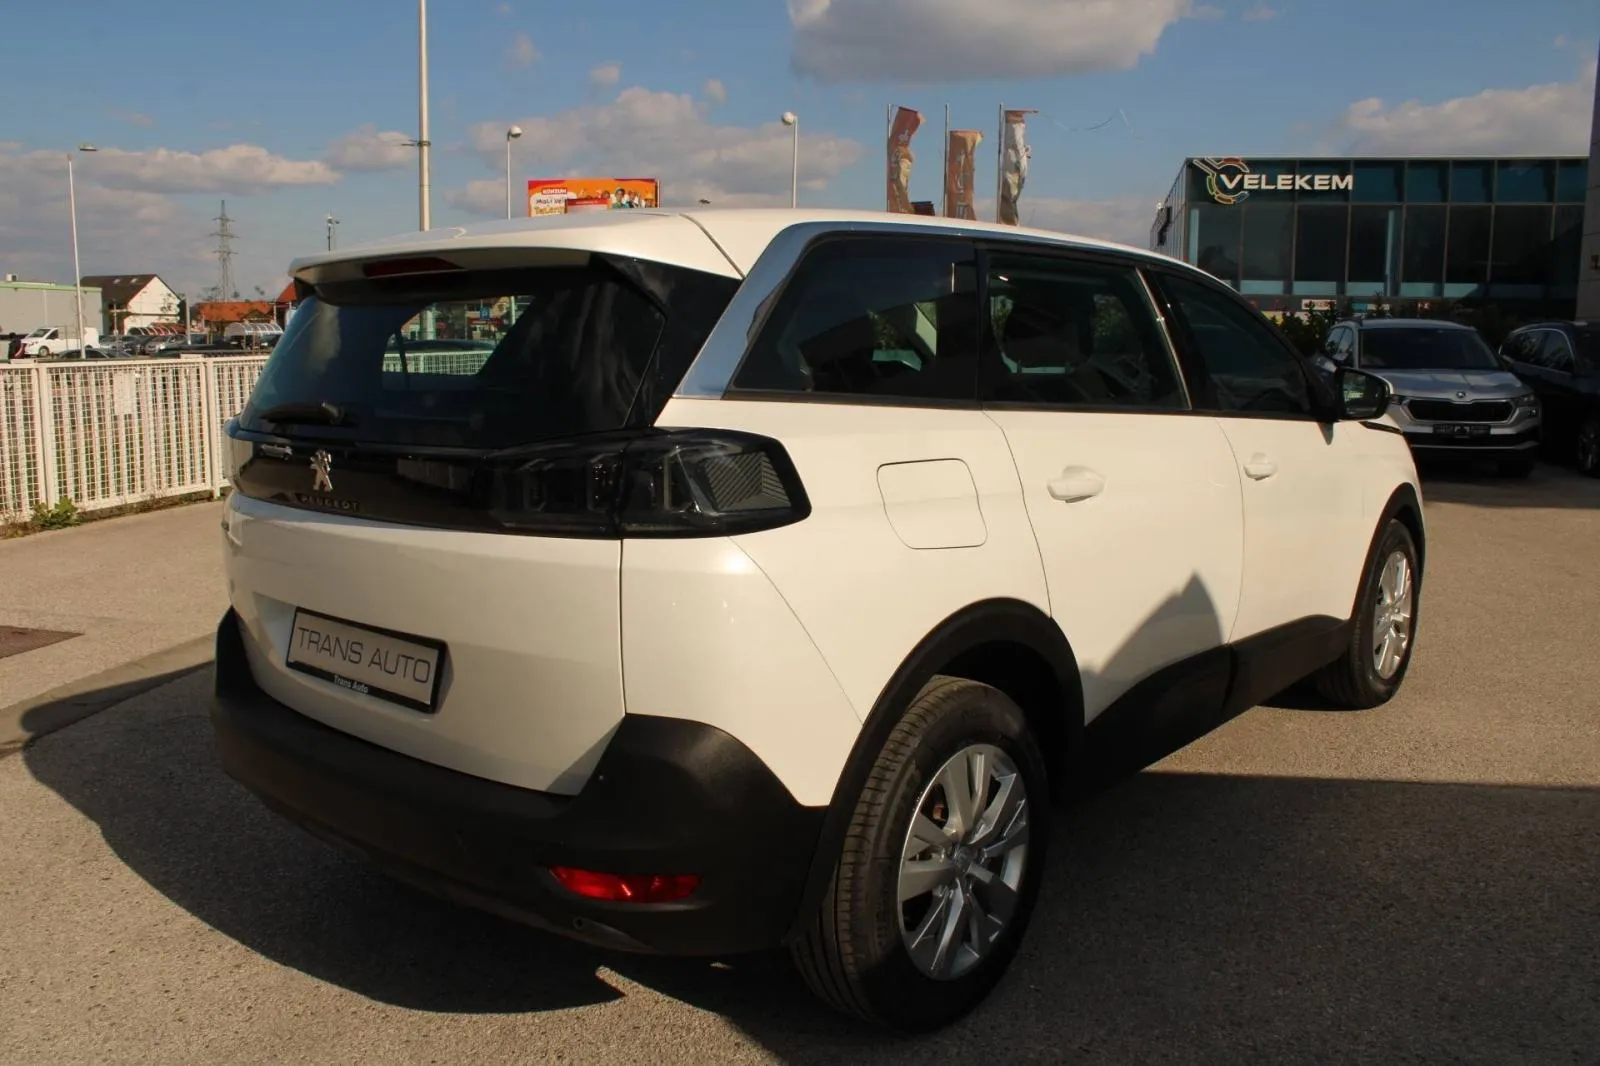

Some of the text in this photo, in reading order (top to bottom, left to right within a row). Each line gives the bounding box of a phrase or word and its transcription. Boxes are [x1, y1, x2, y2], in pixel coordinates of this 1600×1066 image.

[1219, 174, 1353, 191] VELEKEM
[298, 627, 431, 684] TRANS AUTO
[333, 675, 369, 694] Trans Auto
